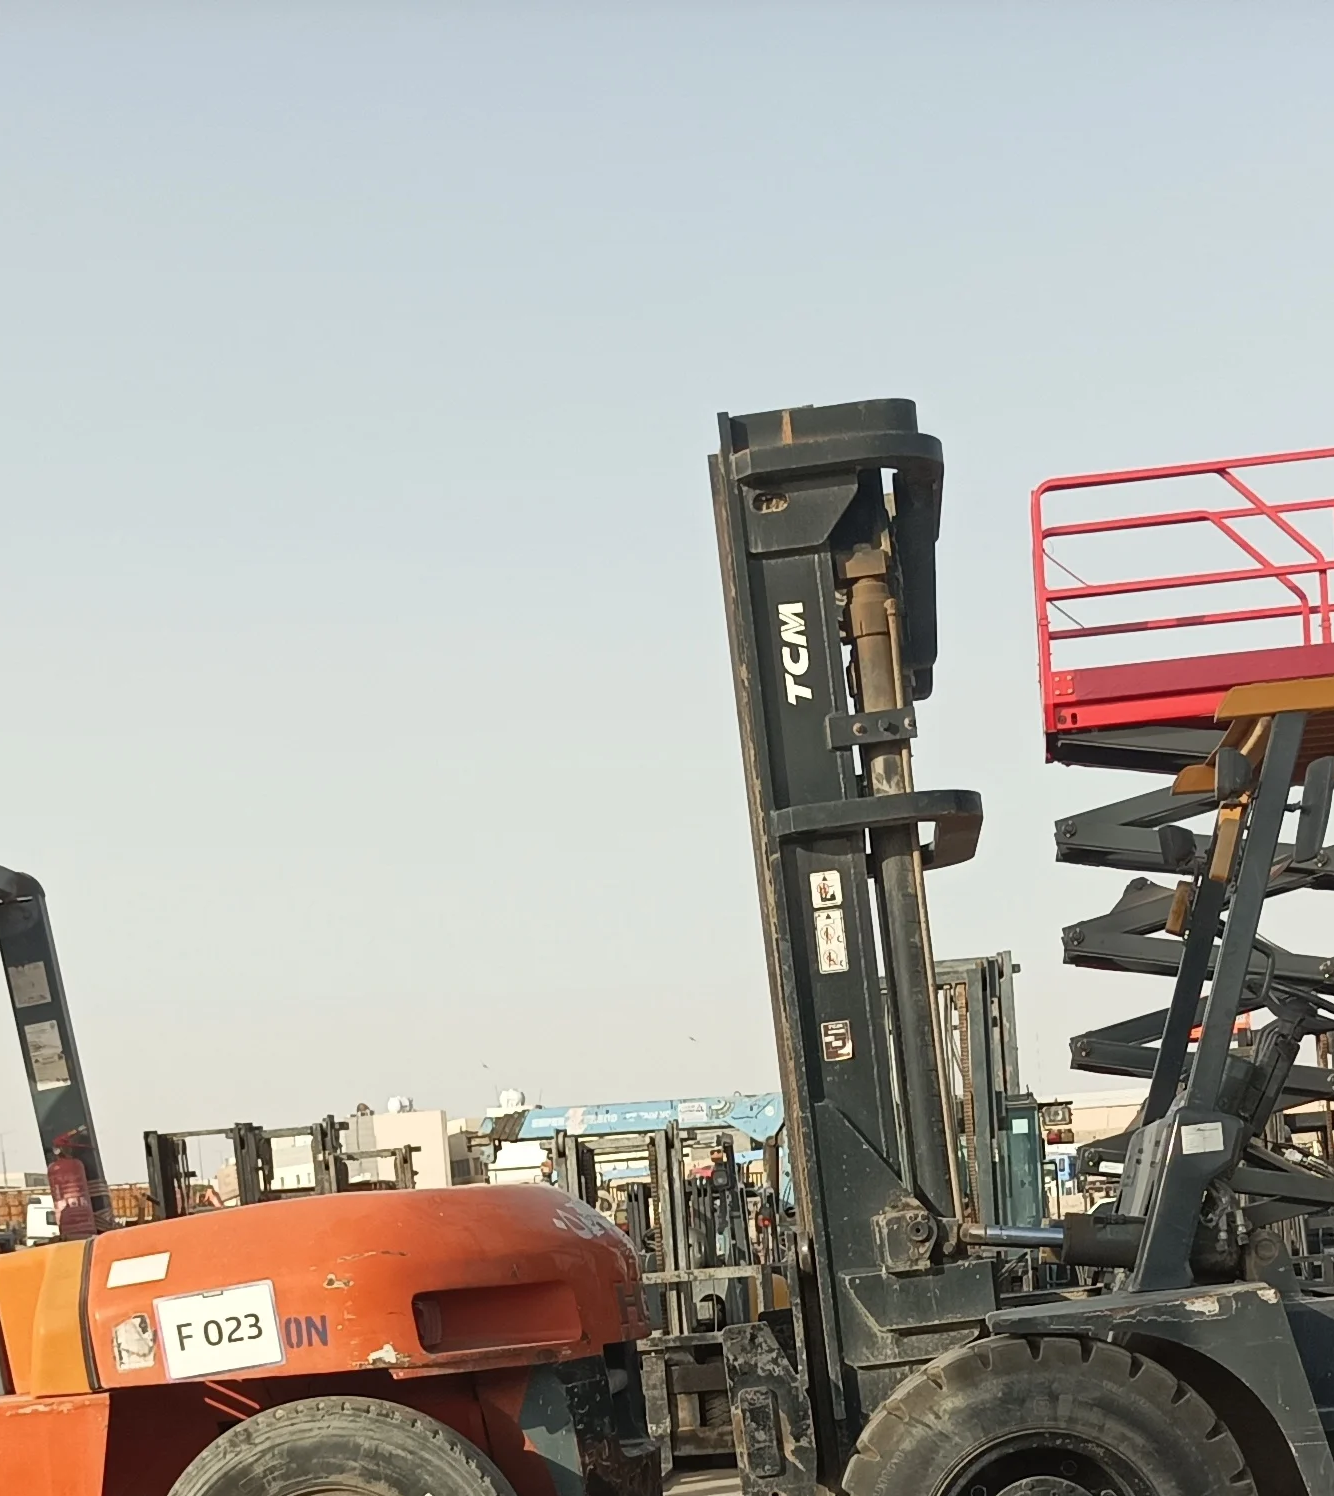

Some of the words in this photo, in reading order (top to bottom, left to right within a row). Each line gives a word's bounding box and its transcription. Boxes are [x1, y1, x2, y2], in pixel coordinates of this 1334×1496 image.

[777, 602, 813, 706] TCM
[175, 1322, 194, 1351] F
[203, 1312, 263, 1347] 023
